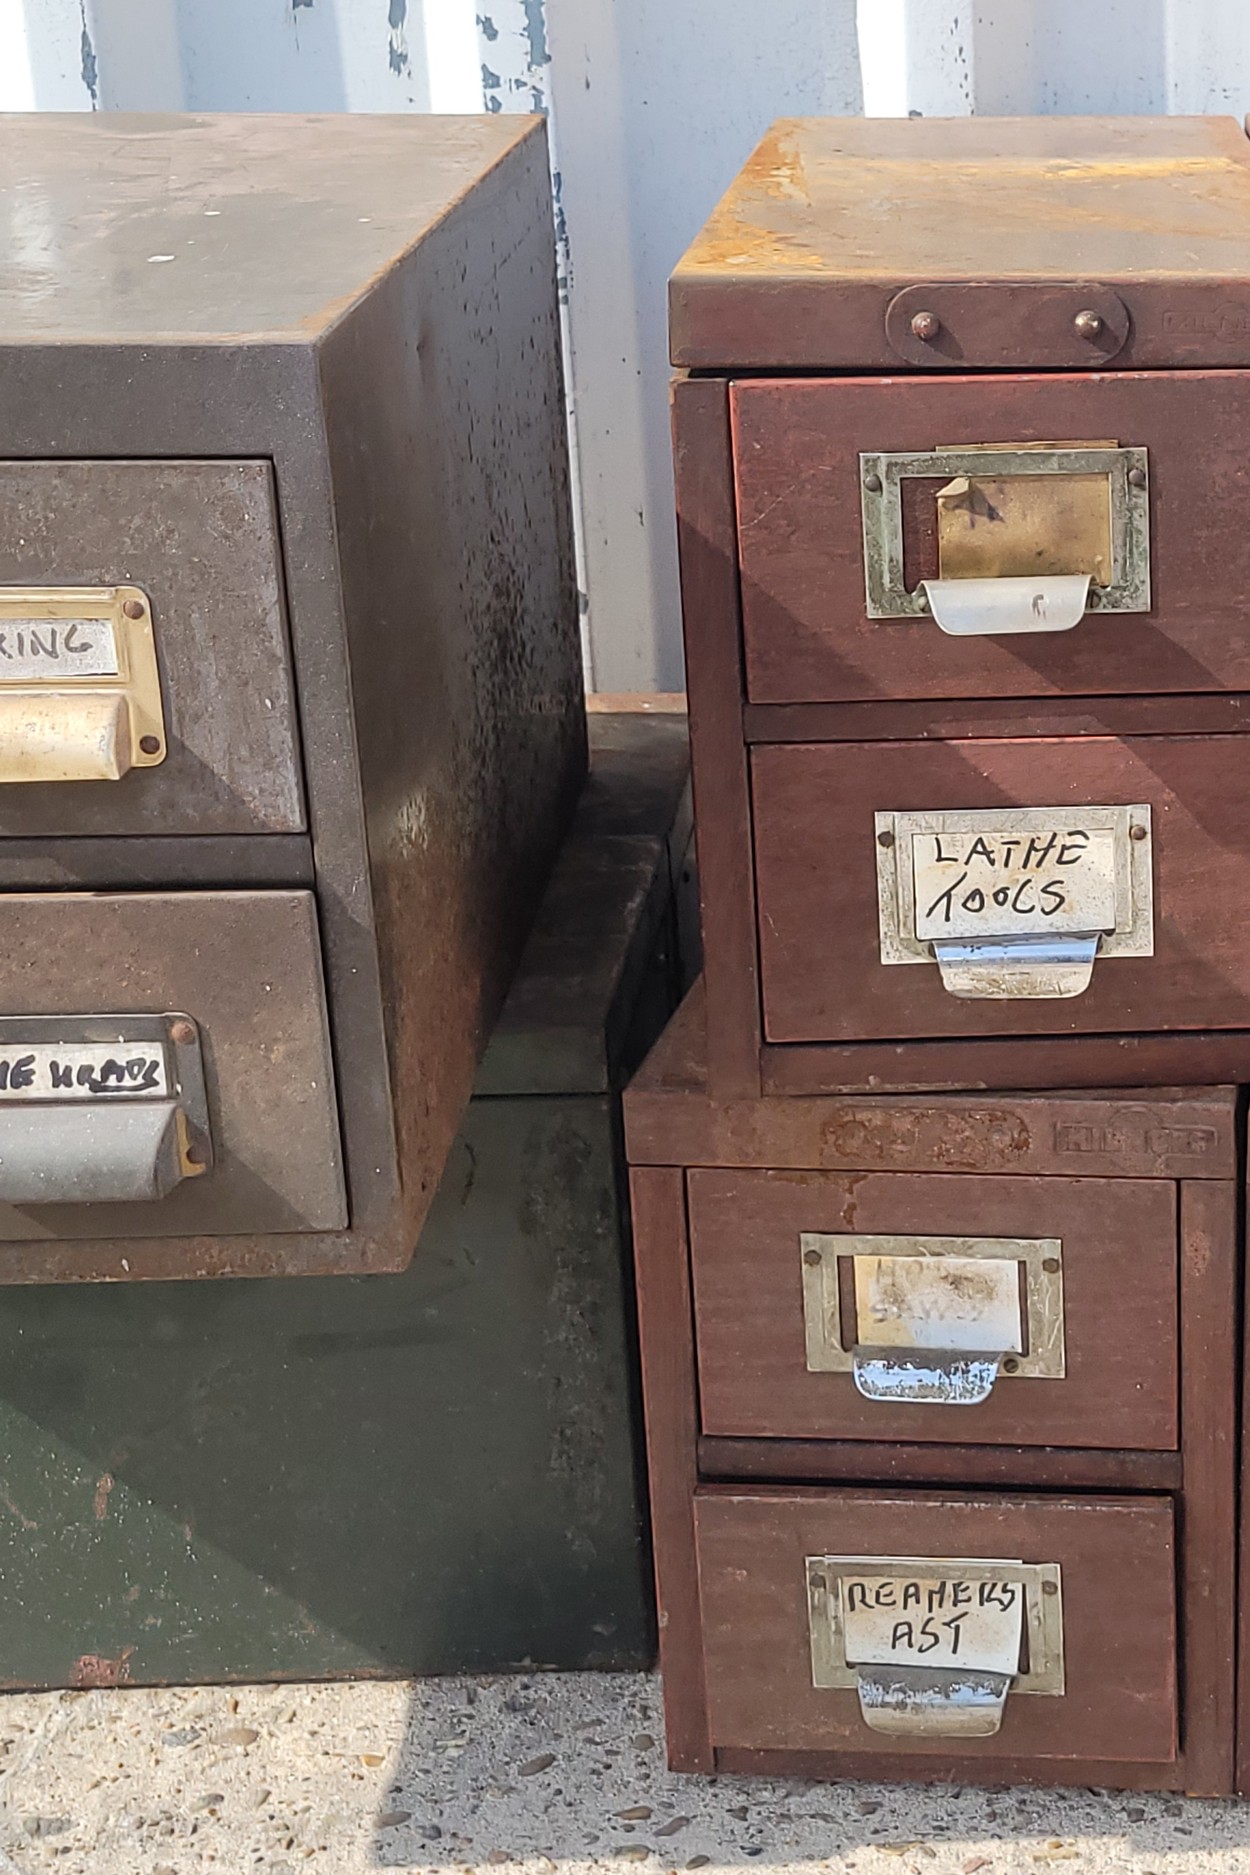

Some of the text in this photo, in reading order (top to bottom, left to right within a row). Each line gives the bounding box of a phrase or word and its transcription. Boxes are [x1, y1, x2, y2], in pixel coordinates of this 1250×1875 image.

[935, 830, 1090, 870] LATHE
[925, 871, 1067, 922] TOOLS
[847, 1580, 1016, 1613] REAMERS
[891, 1611, 970, 1655] AST
